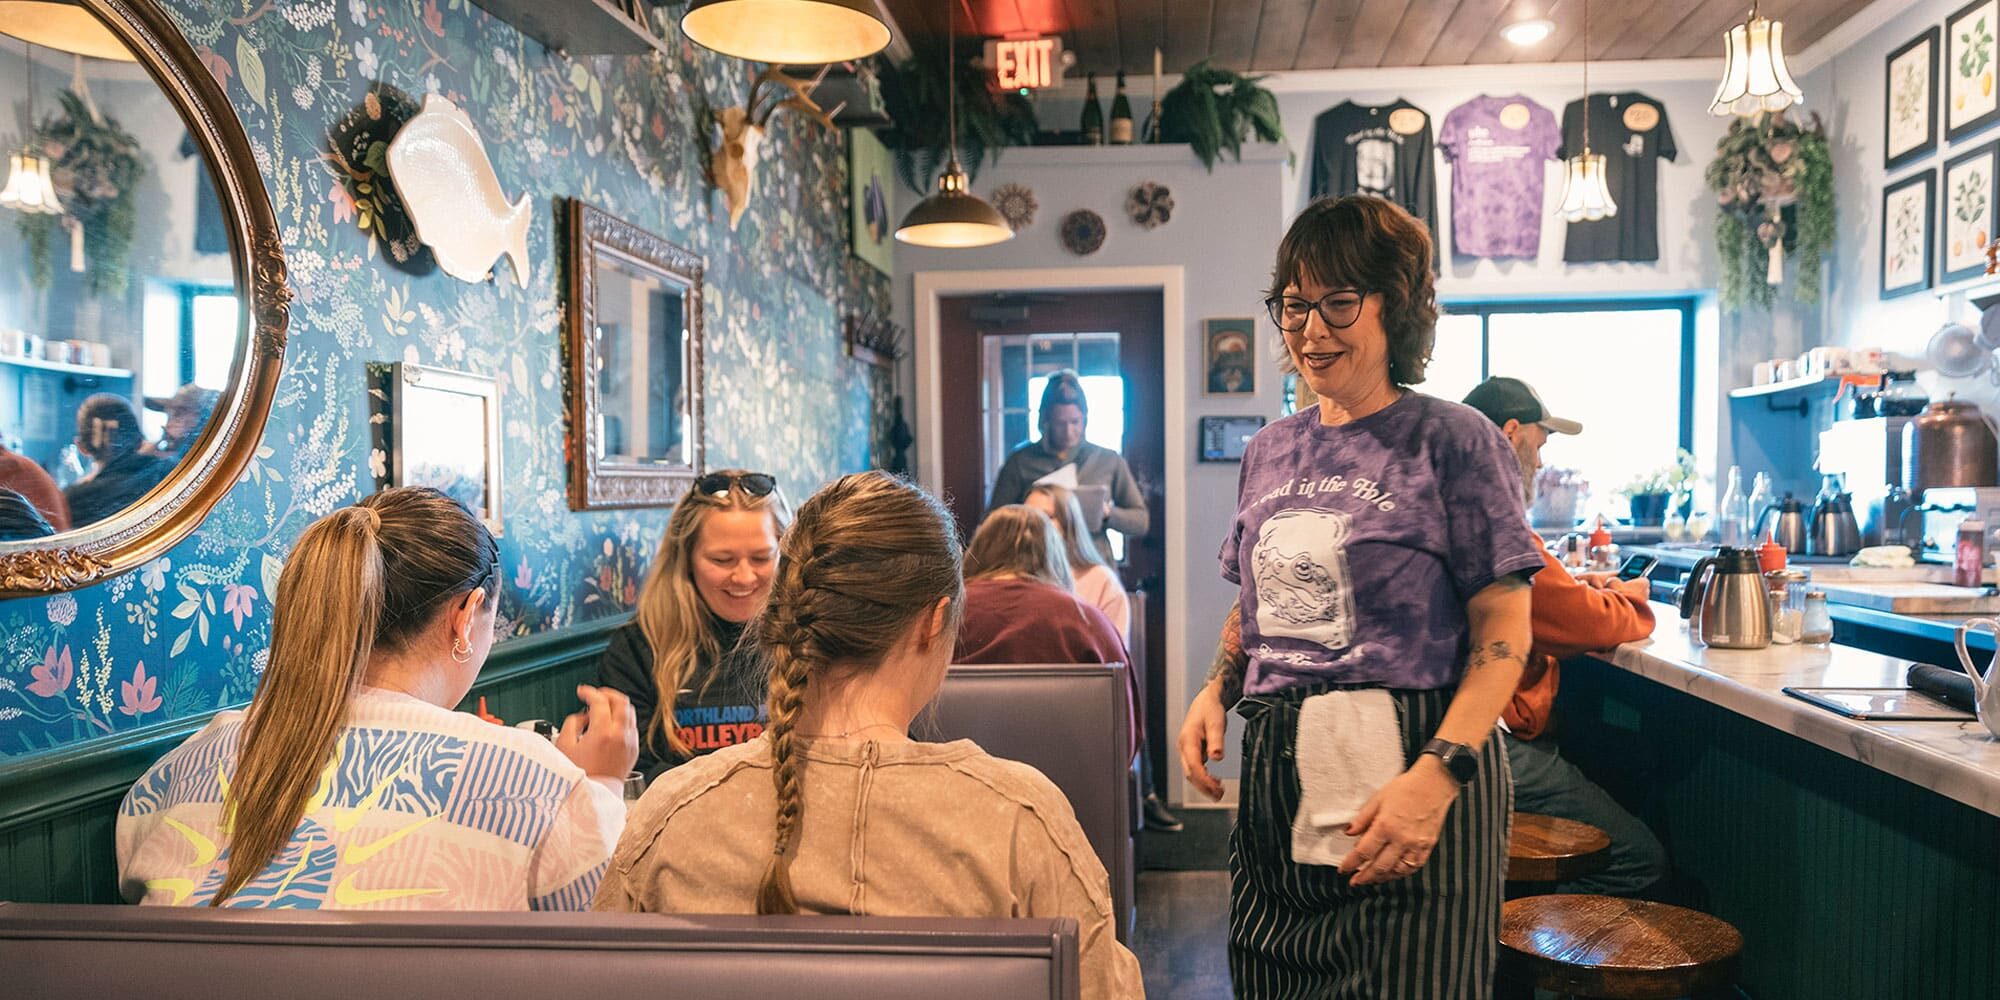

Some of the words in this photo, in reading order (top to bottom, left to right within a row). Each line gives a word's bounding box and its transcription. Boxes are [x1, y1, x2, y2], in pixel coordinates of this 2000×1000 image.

[997, 40, 1053, 88] EXIT
[1297, 478, 1315, 498] in
[1318, 475, 1347, 493] the
[1352, 478, 1396, 512] Hole
[675, 705, 756, 726] ORTHLAND
